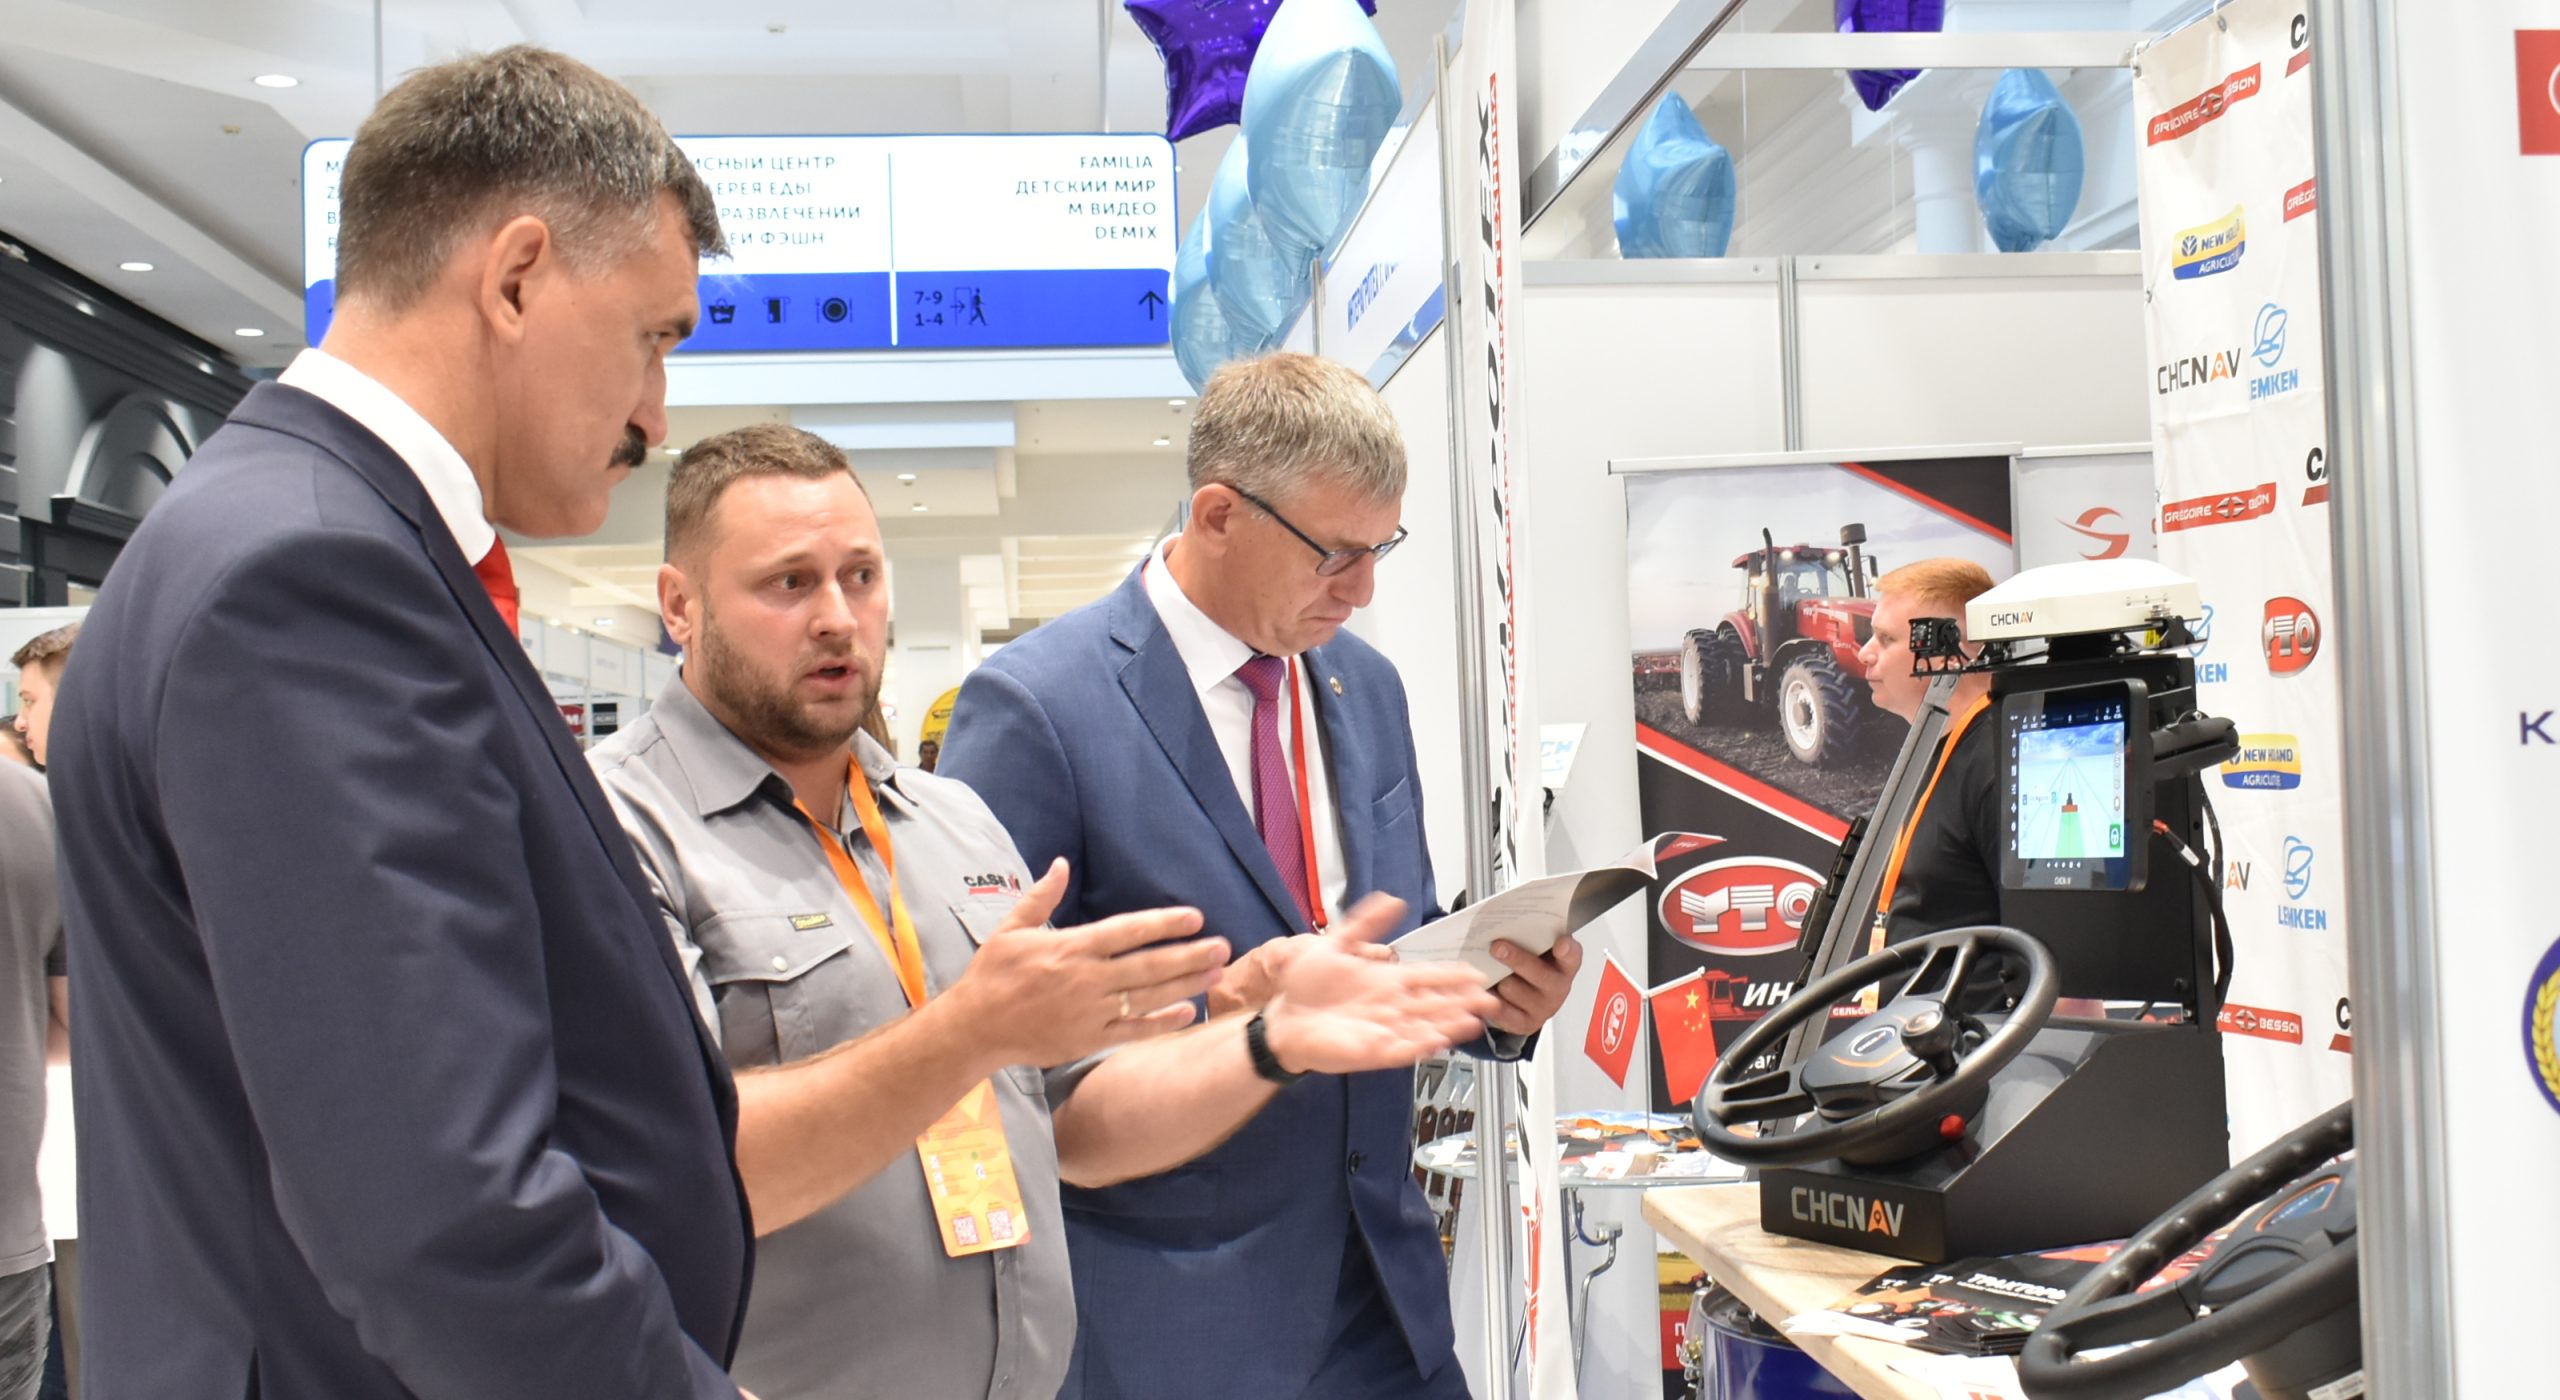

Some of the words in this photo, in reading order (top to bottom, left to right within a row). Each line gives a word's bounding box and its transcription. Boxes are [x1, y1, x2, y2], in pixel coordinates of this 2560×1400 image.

[771, 156, 835, 171] ЦЕНТР
[1080, 155, 1153, 169] FAMILIA
[716, 182, 762, 196] ЕРЕЯ
[770, 182, 811, 196] ЕДЫ
[1114, 180, 1156, 193] МИР
[1091, 202, 1157, 216] ВИДЕО
[761, 231, 824, 245] ФЭШН
[1095, 226, 1157, 239] DEMIX
[2201, 232, 2225, 251] NEW
[914, 291, 943, 305] 7-9
[915, 313, 944, 326] 1-4
[2157, 347, 2242, 396] CHCNAV
[2250, 368, 2299, 400] EMKEN
[1990, 611, 2034, 627] CHCNAV
[2195, 663, 2228, 684] KEN
[2243, 748, 2266, 763] NEW
[2259, 1016, 2300, 1034] BESSON
[1791, 1186, 1904, 1238] CHCNAV
